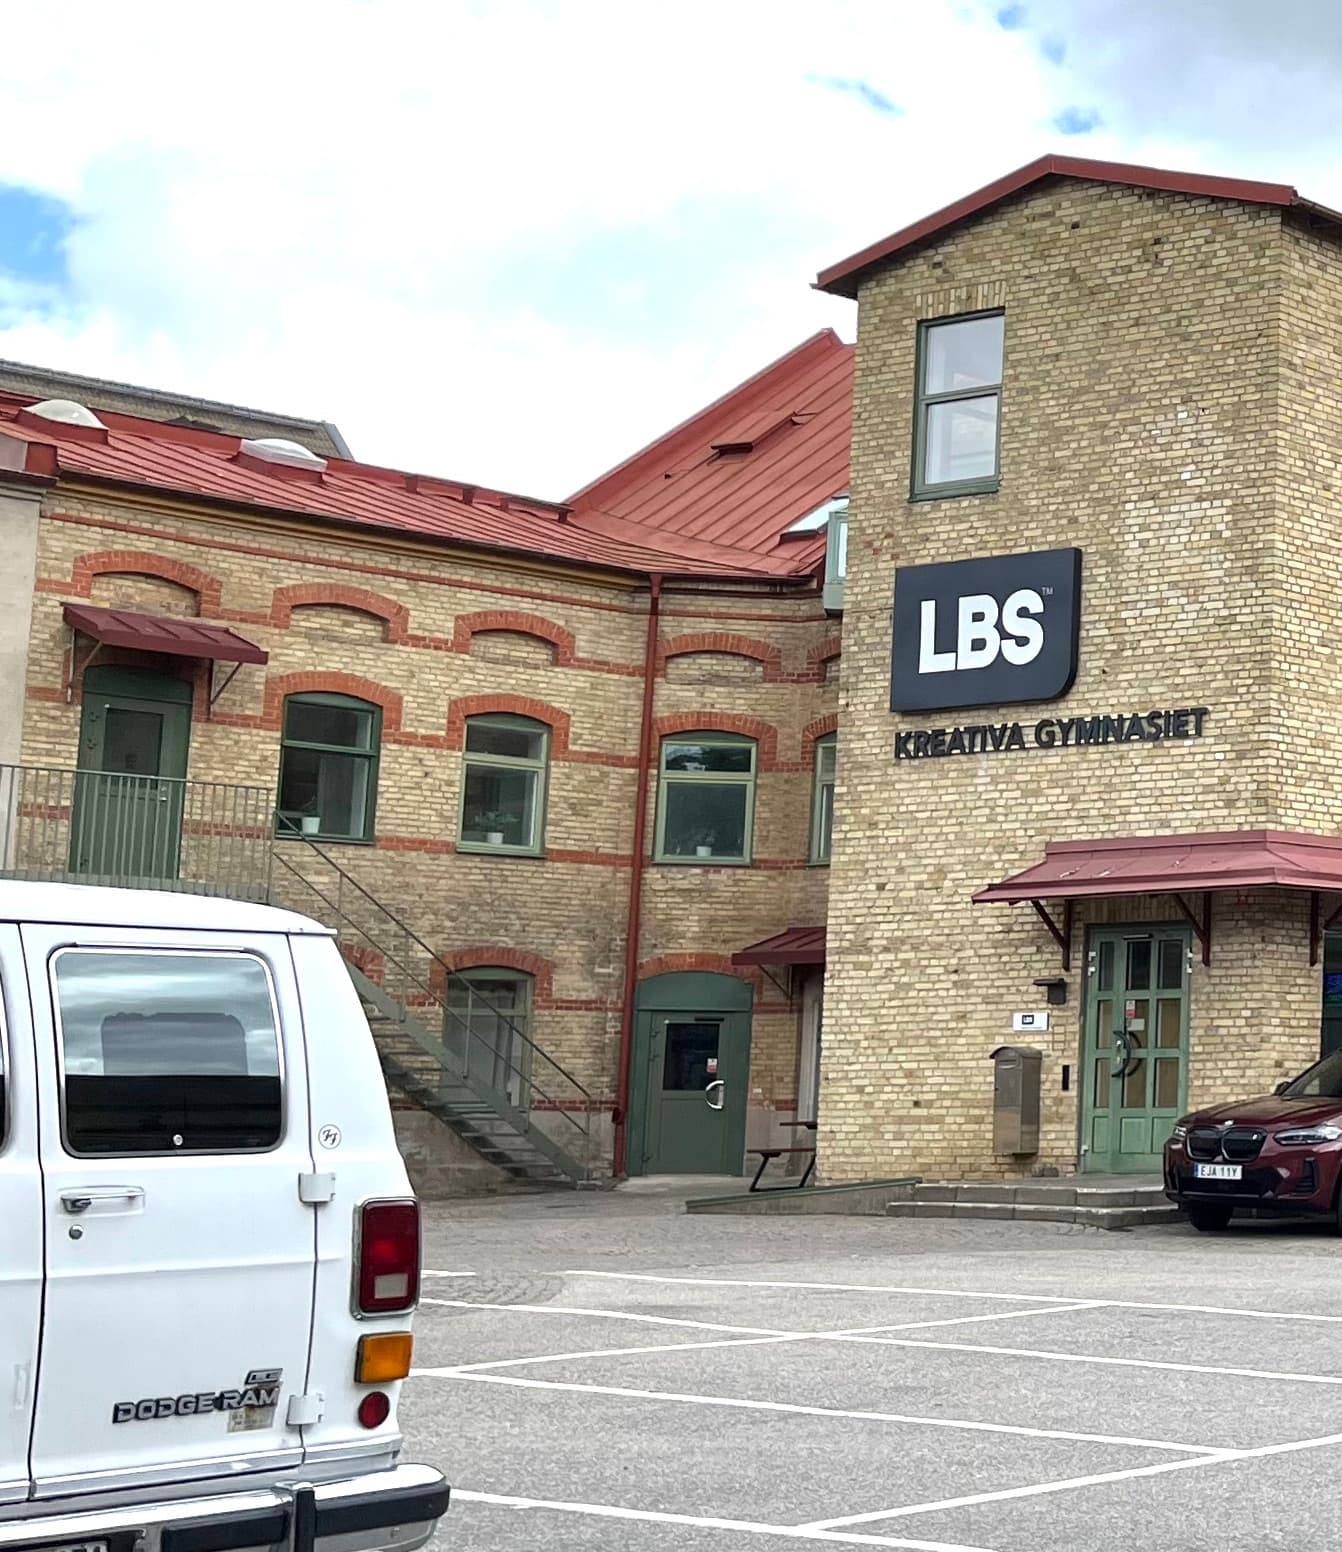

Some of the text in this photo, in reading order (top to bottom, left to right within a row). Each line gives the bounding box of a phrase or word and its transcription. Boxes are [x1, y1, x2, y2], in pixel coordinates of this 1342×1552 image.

[918, 588, 1045, 674] LBS
[895, 707, 1208, 759] KREATIVA GYMNASIET
[1201, 1165, 1217, 1177] EJA
[113, 1392, 215, 1424] DODGE
[219, 1386, 281, 1411] RAM
